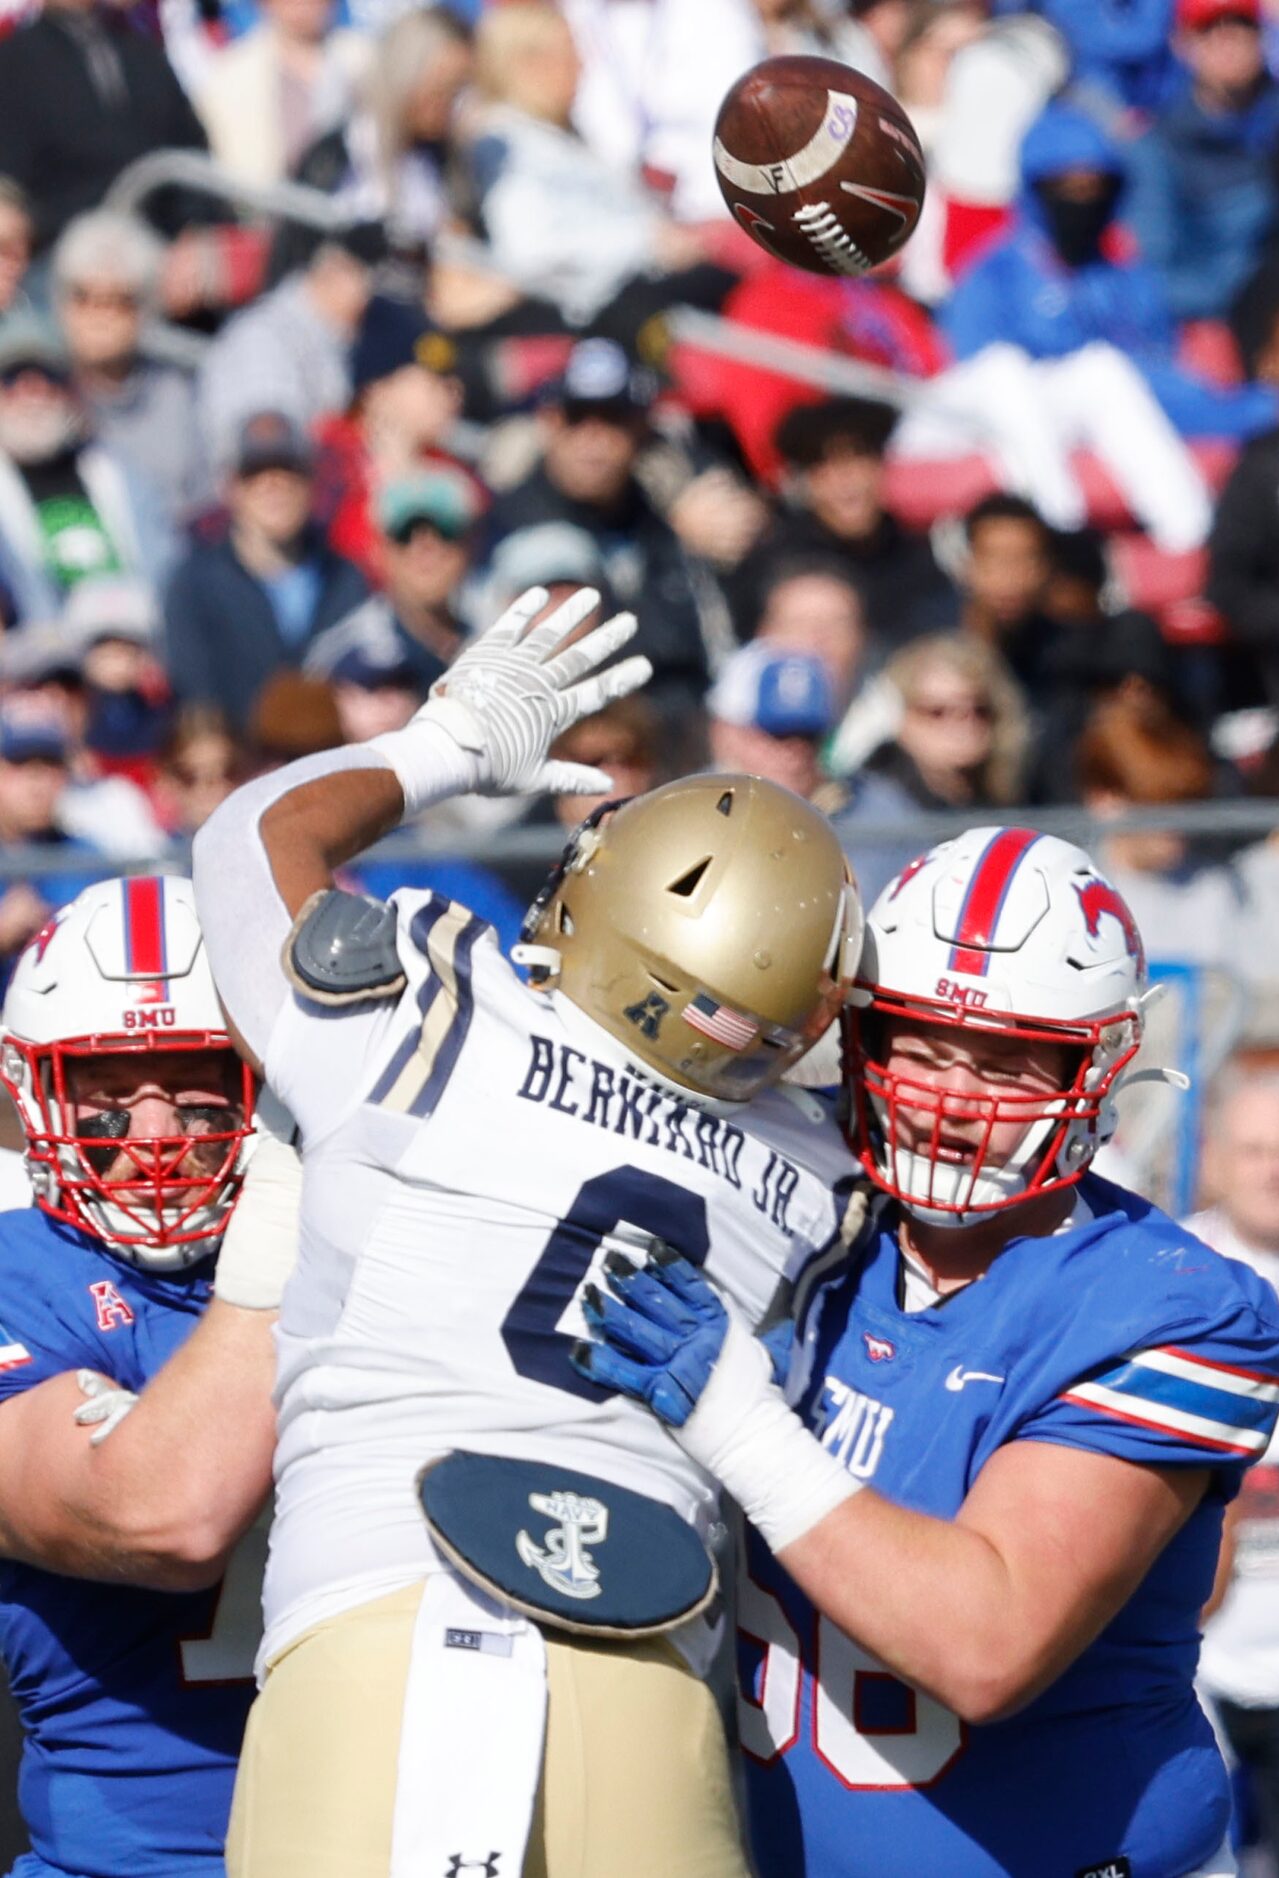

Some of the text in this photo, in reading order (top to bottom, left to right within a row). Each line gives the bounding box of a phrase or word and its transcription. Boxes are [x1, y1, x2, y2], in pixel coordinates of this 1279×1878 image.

[935, 977, 988, 1008] SMU
[123, 1007, 176, 1029] SMU
[516, 1033, 745, 1190] BERNARD
